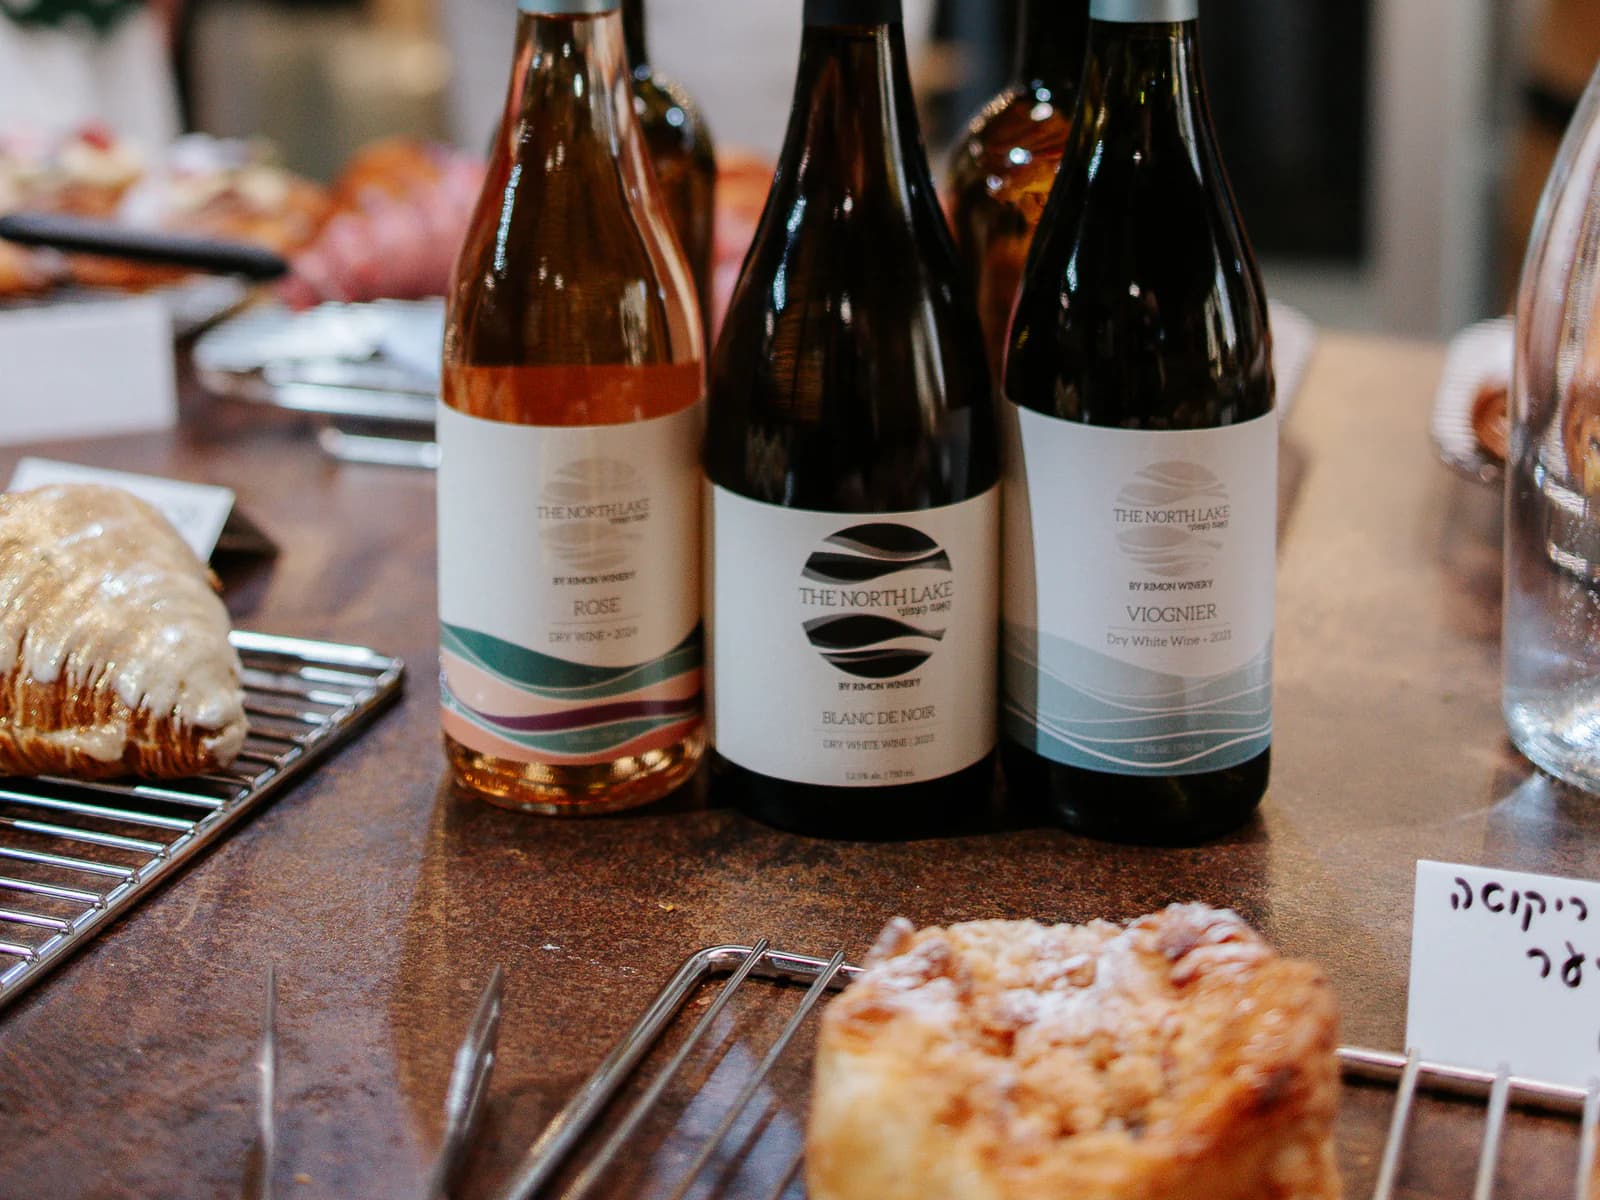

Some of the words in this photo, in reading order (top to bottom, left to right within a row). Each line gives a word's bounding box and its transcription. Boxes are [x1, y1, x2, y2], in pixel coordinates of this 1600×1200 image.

[536, 506, 566, 520] THE
[568, 504, 618, 520] NORTH
[620, 498, 649, 515] LAKE
[1113, 508, 1143, 523] THE
[1145, 509, 1195, 524] NORTH
[1198, 505, 1230, 522] LAKE
[552, 577, 565, 586] BY
[600, 571, 637, 584] WINERY
[1129, 581, 1141, 591] BY
[1144, 581, 1176, 591] RIMON
[1177, 579, 1214, 591] WINERY
[799, 587, 836, 607] THE
[840, 588, 907, 607] NORTH
[911, 581, 953, 605] LAKE
[573, 597, 622, 617] ROSE
[1126, 604, 1217, 623] VIOGNIER
[575, 629, 605, 643] WINE
[1106, 632, 1129, 647] Dry
[1132, 635, 1168, 648] White
[1170, 635, 1200, 647] Wine
[838, 682, 850, 691] BY
[853, 681, 884, 691] RIMON
[886, 678, 921, 690] WINERY
[821, 711, 874, 725] BLANC
[877, 711, 898, 725] DE
[901, 705, 936, 723] NOIR
[823, 738, 843, 749] DRY
[847, 738, 880, 751] WHITE
[882, 737, 908, 749] WINE
